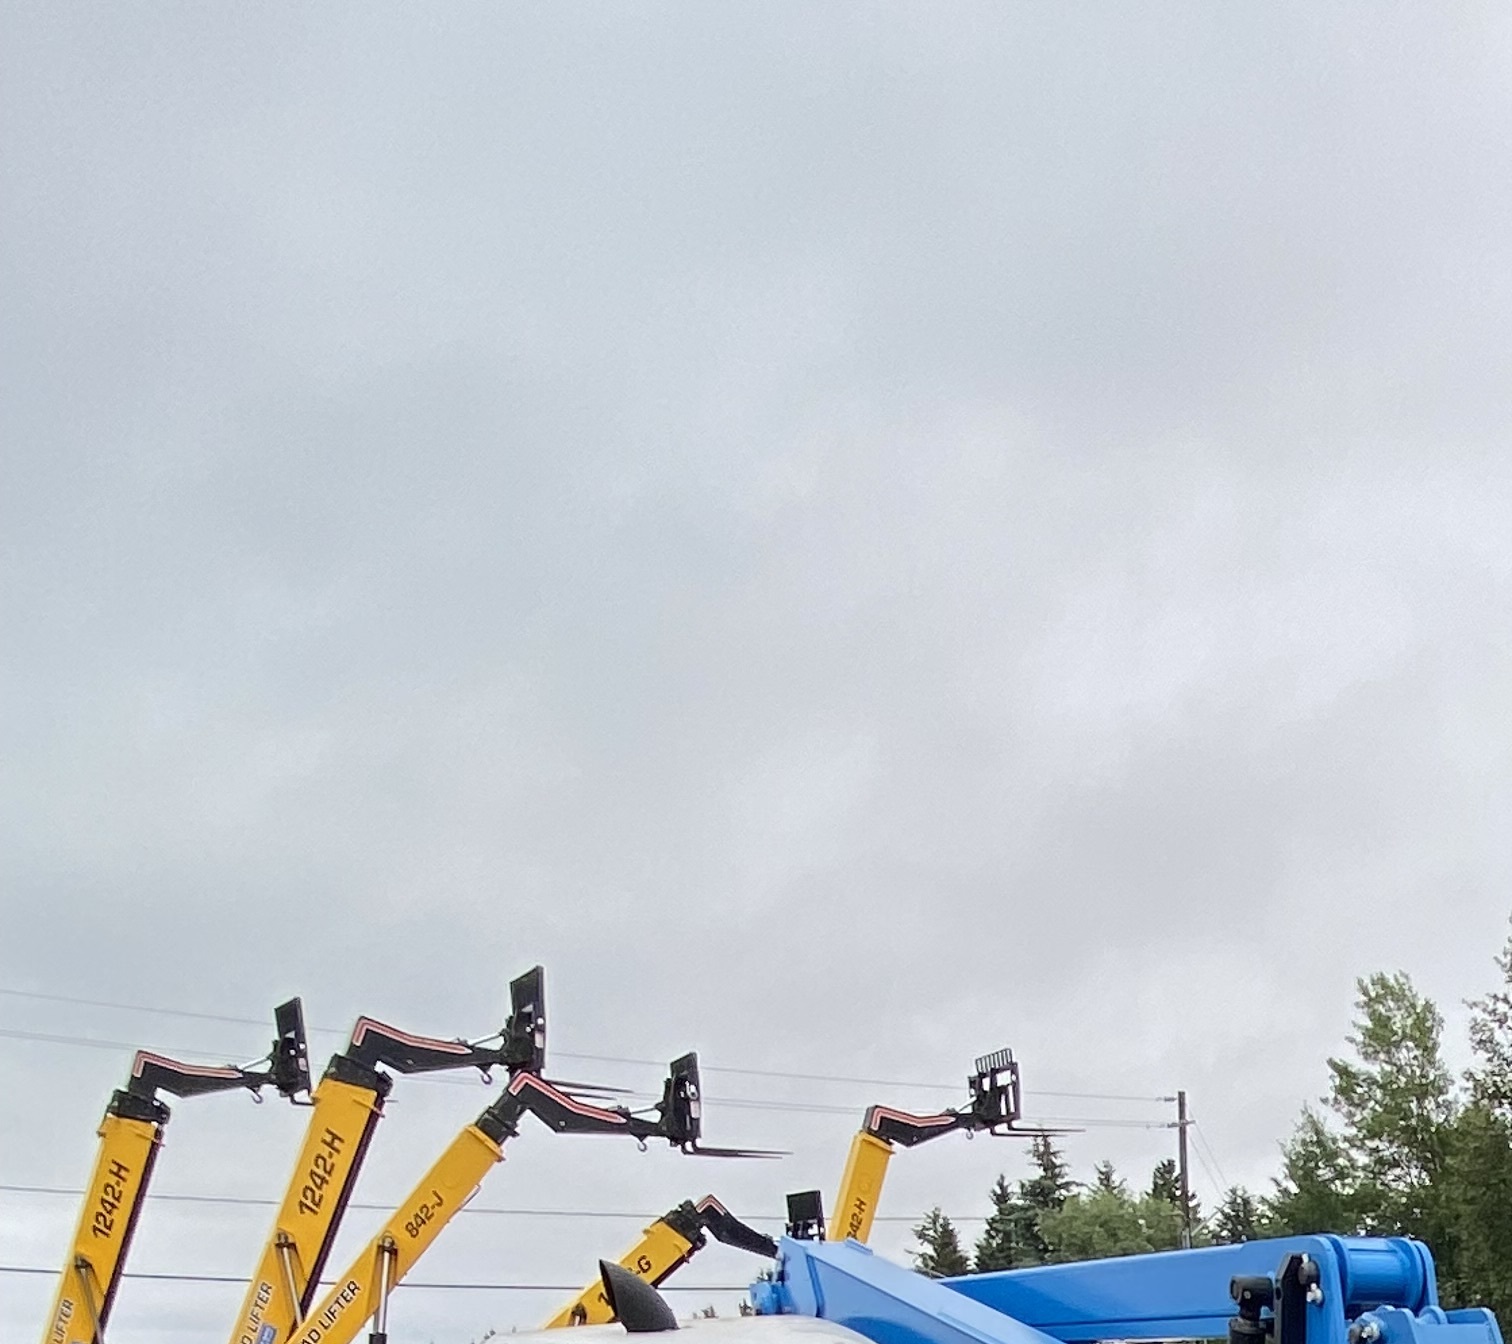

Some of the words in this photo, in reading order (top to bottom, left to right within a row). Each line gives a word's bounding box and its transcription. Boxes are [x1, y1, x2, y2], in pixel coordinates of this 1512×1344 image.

[298, 1127, 346, 1216] 1242-H
[92, 1159, 130, 1239] 1242-H
[404, 1190, 445, 1239] 842-J
[52, 1298, 75, 1344] LIFTER
[249, 1282, 273, 1334] LIFTER
[320, 1280, 362, 1331] LIFTER
